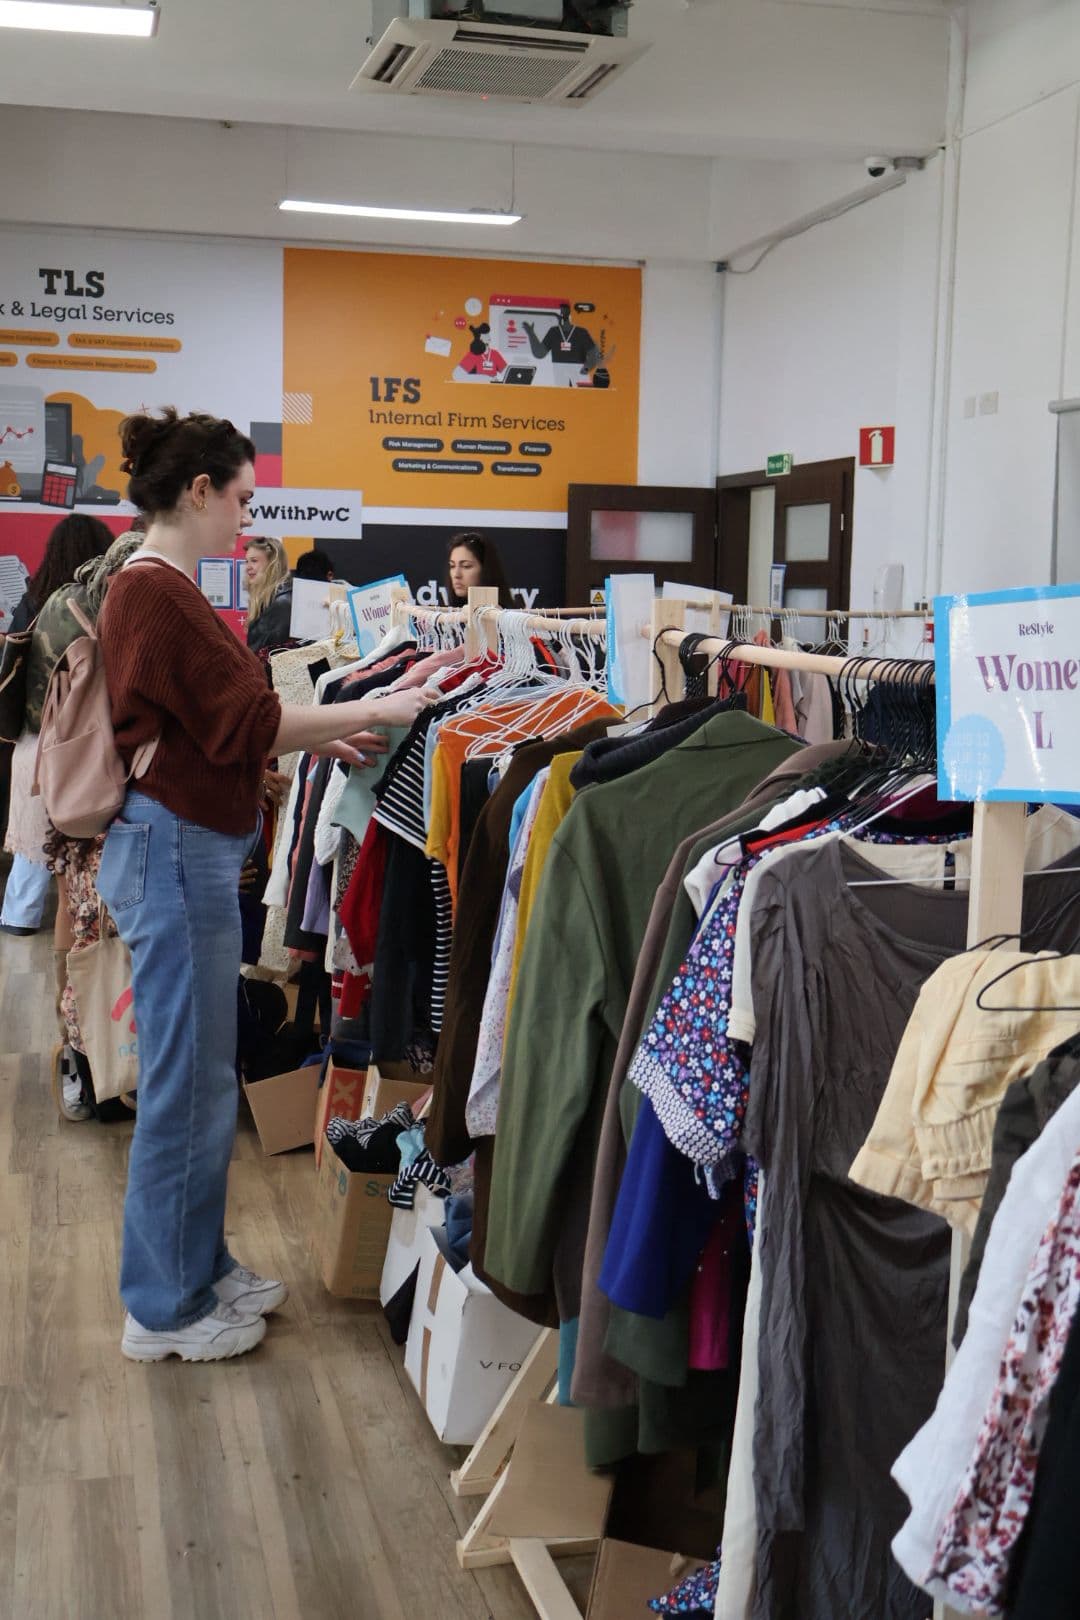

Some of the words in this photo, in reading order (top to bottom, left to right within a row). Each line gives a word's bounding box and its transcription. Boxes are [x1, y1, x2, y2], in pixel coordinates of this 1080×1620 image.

[39, 267, 105, 298] TLS
[11, 300, 24, 316] &
[30, 302, 87, 322] Legal
[92, 305, 175, 325] Services
[369, 376, 421, 404] IFS
[368, 409, 442, 427] Internal
[447, 413, 487, 428] Firm
[492, 415, 566, 431] Services
[388, 440, 401, 448] Risk
[402, 441, 438, 449] Management
[524, 445, 546, 453] Finance
[398, 461, 426, 471] Marketing
[431, 463, 478, 472] Communications
[496, 464, 537, 473] Transformation
[379, 624, 387, 638] S
[1018, 622, 1055, 637] ReStyle
[975, 654, 1080, 693] Wome
[1033, 711, 1054, 749] L
